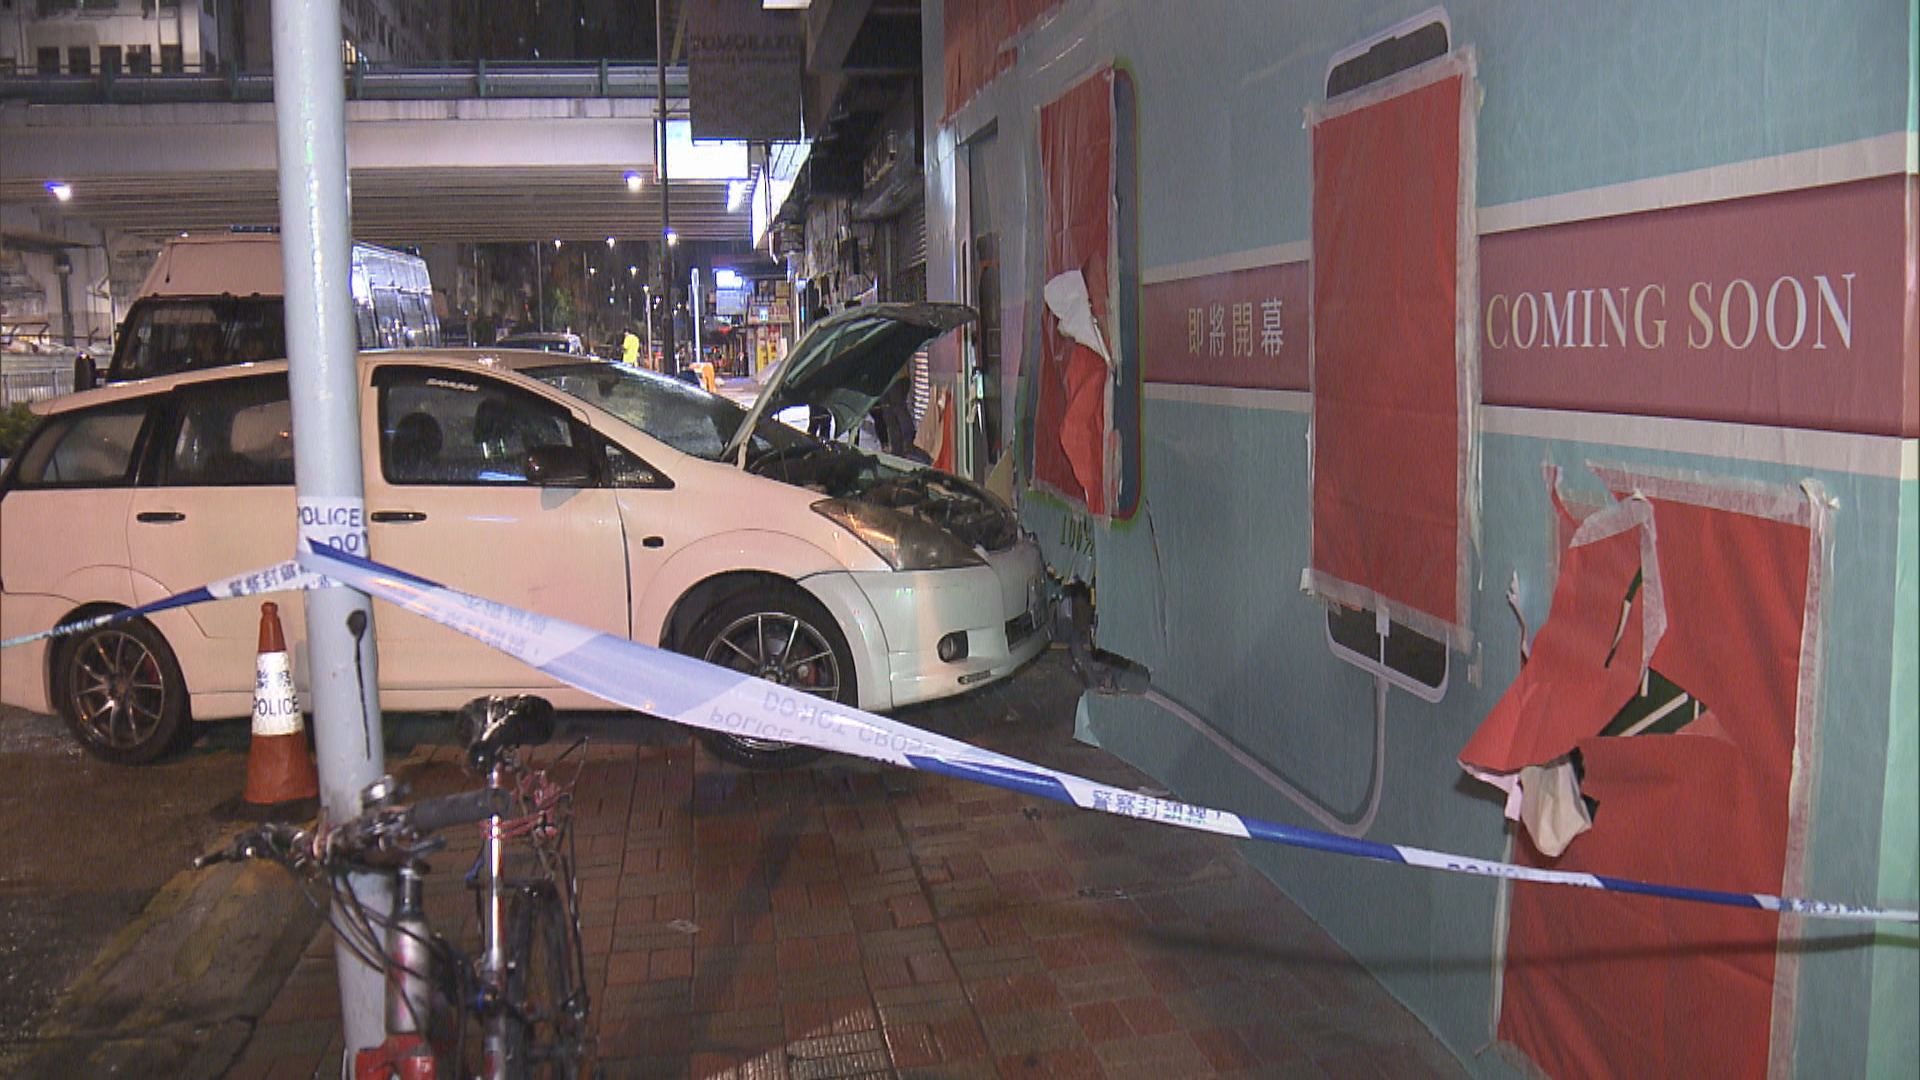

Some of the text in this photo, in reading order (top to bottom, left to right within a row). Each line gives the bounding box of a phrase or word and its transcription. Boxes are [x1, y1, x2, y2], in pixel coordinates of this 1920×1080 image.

[1188, 297, 1284, 357] 即將開幕
[1486, 273, 1856, 350] COMING SOON
